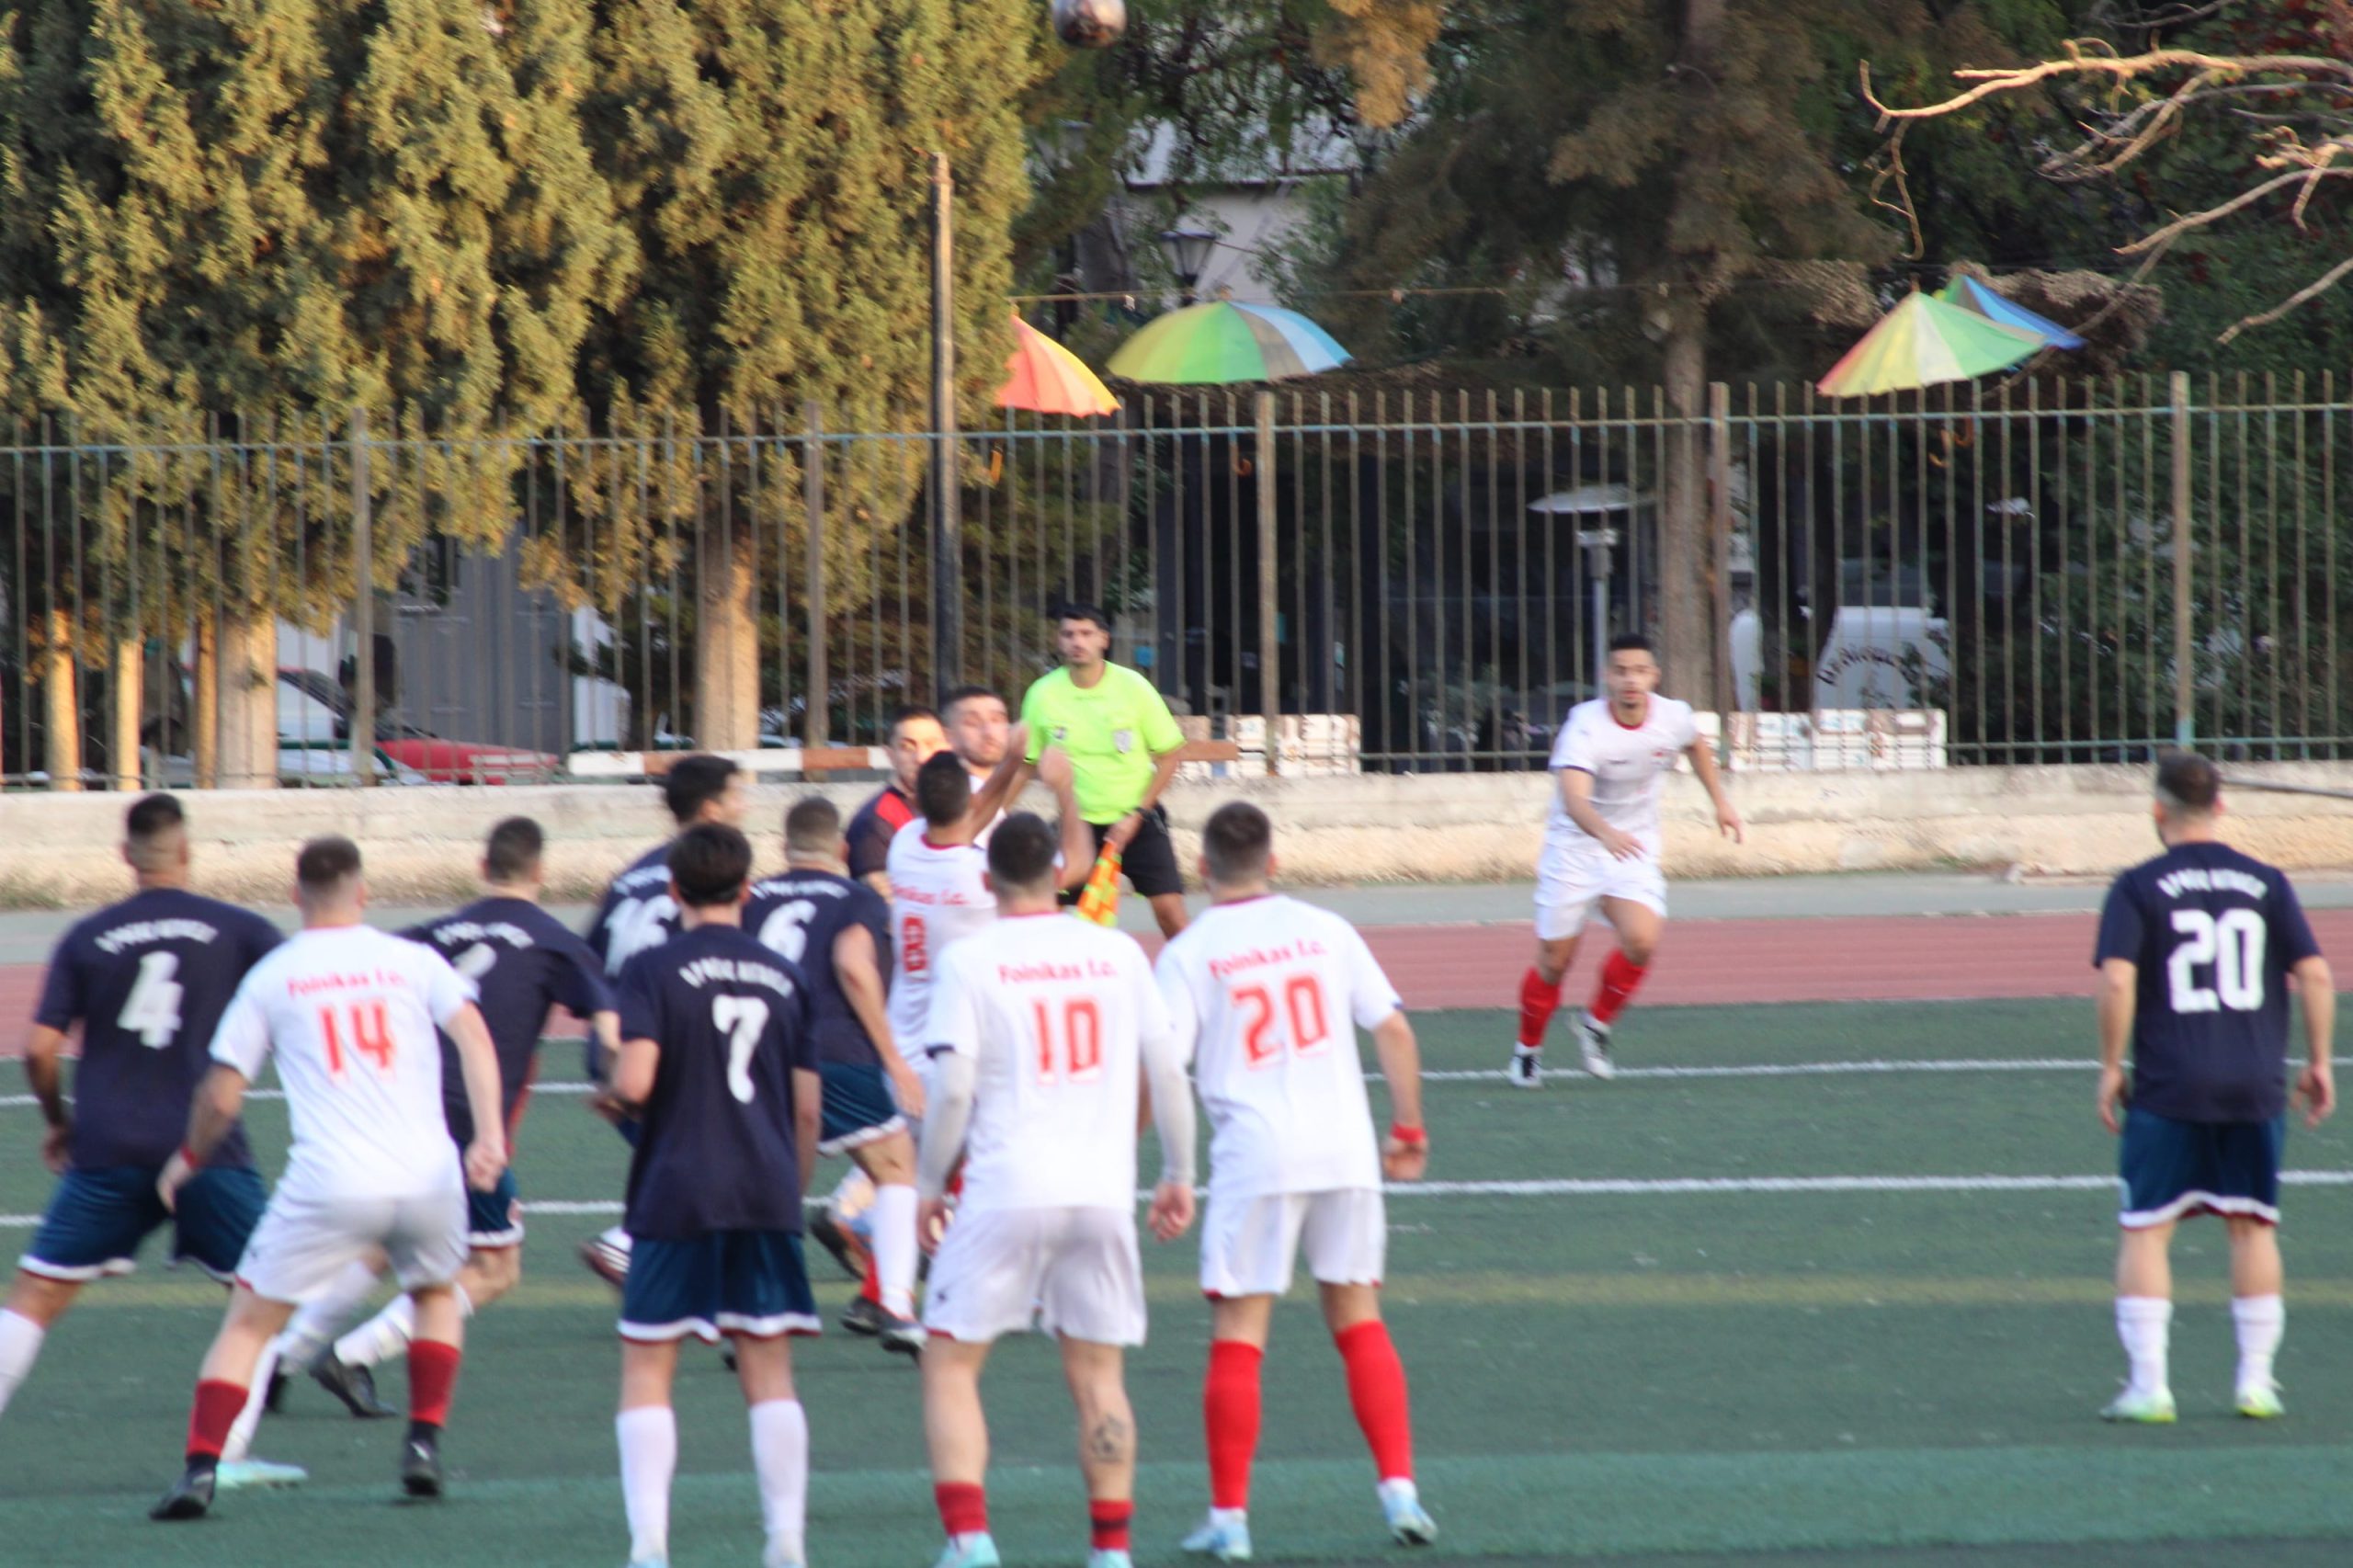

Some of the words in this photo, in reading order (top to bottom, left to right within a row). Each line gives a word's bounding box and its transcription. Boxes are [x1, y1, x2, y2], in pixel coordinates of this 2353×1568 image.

[757, 899, 817, 966] 6
[902, 914, 927, 976] 8
[2167, 908, 2267, 1013] 20
[117, 950, 184, 1050] 4
[317, 999, 397, 1075] 14
[1030, 994, 1100, 1081] 10
[1230, 972, 1330, 1066] 20
[711, 994, 770, 1105] 7
